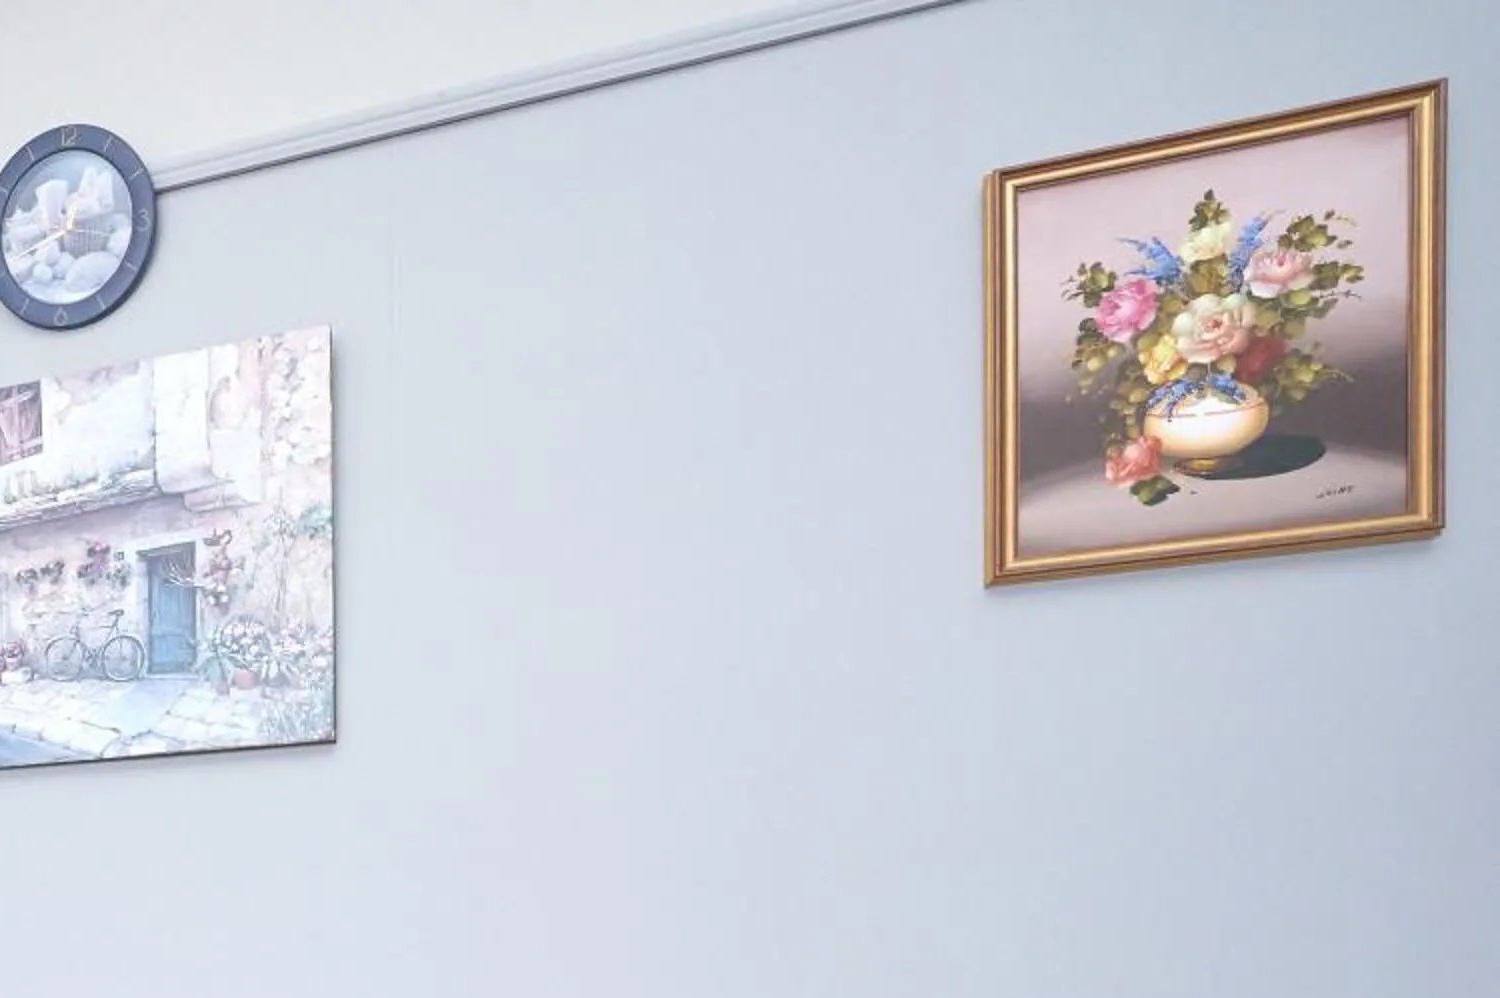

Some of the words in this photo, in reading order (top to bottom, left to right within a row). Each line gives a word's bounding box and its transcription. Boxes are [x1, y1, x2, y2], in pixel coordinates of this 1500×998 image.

[60, 126, 77, 145] 12
[135, 210, 150, 231] 3
[53, 307, 68, 326] 6
